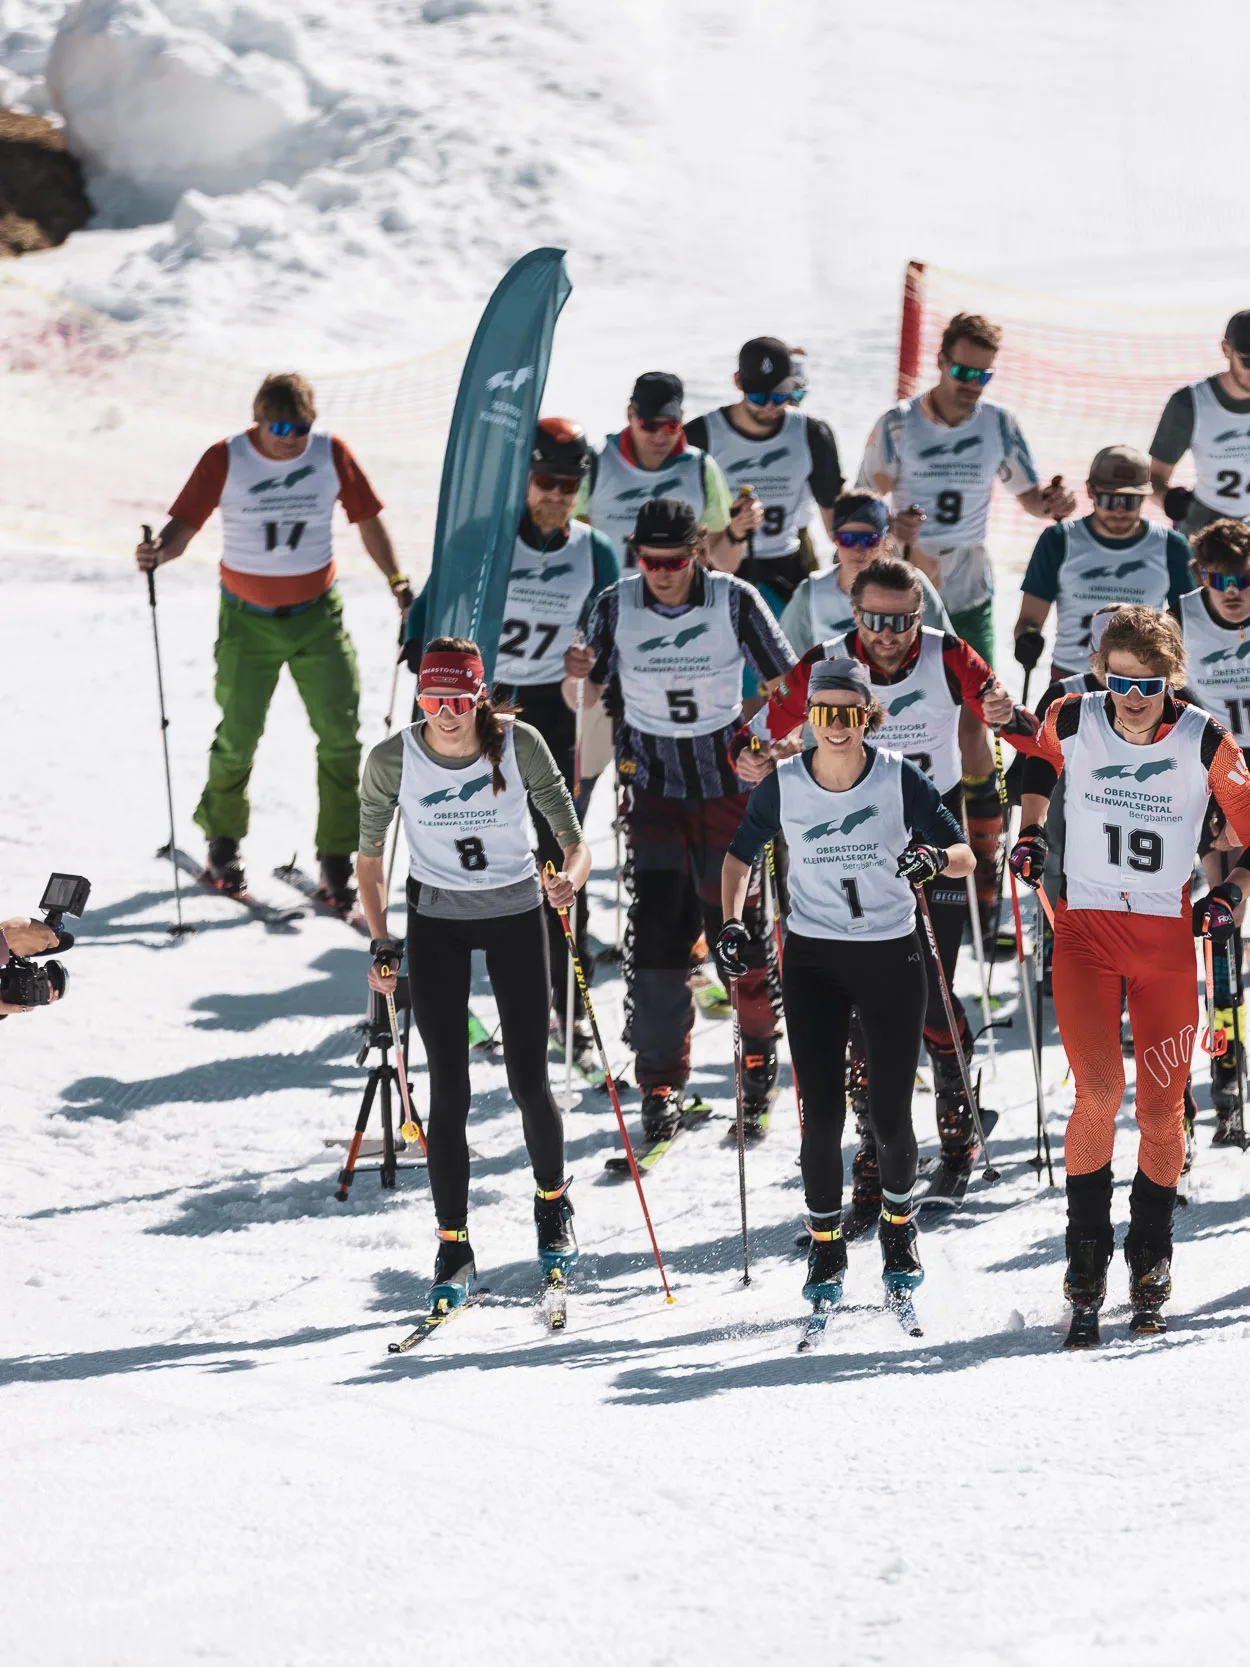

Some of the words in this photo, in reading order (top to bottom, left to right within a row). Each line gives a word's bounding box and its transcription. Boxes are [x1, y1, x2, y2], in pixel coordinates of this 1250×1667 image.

[936, 490, 962, 525] 9
[262, 521, 308, 552] 17
[499, 618, 561, 660] 27
[665, 688, 698, 724] 5
[1085, 792, 1172, 814] KLEINWALSERTAL
[1104, 787, 1173, 804] OBERSTDORF
[418, 817, 499, 827] KLEINWALSERTAL
[433, 809, 498, 820] OBERSTDORF
[1129, 811, 1183, 823] Bergbahnen
[455, 836, 489, 872] 8
[803, 852, 879, 865] KLEINWALSERTAL
[816, 843, 879, 855] OBERSTDORF
[1103, 822, 1164, 875] 19
[840, 877, 865, 920] 1
